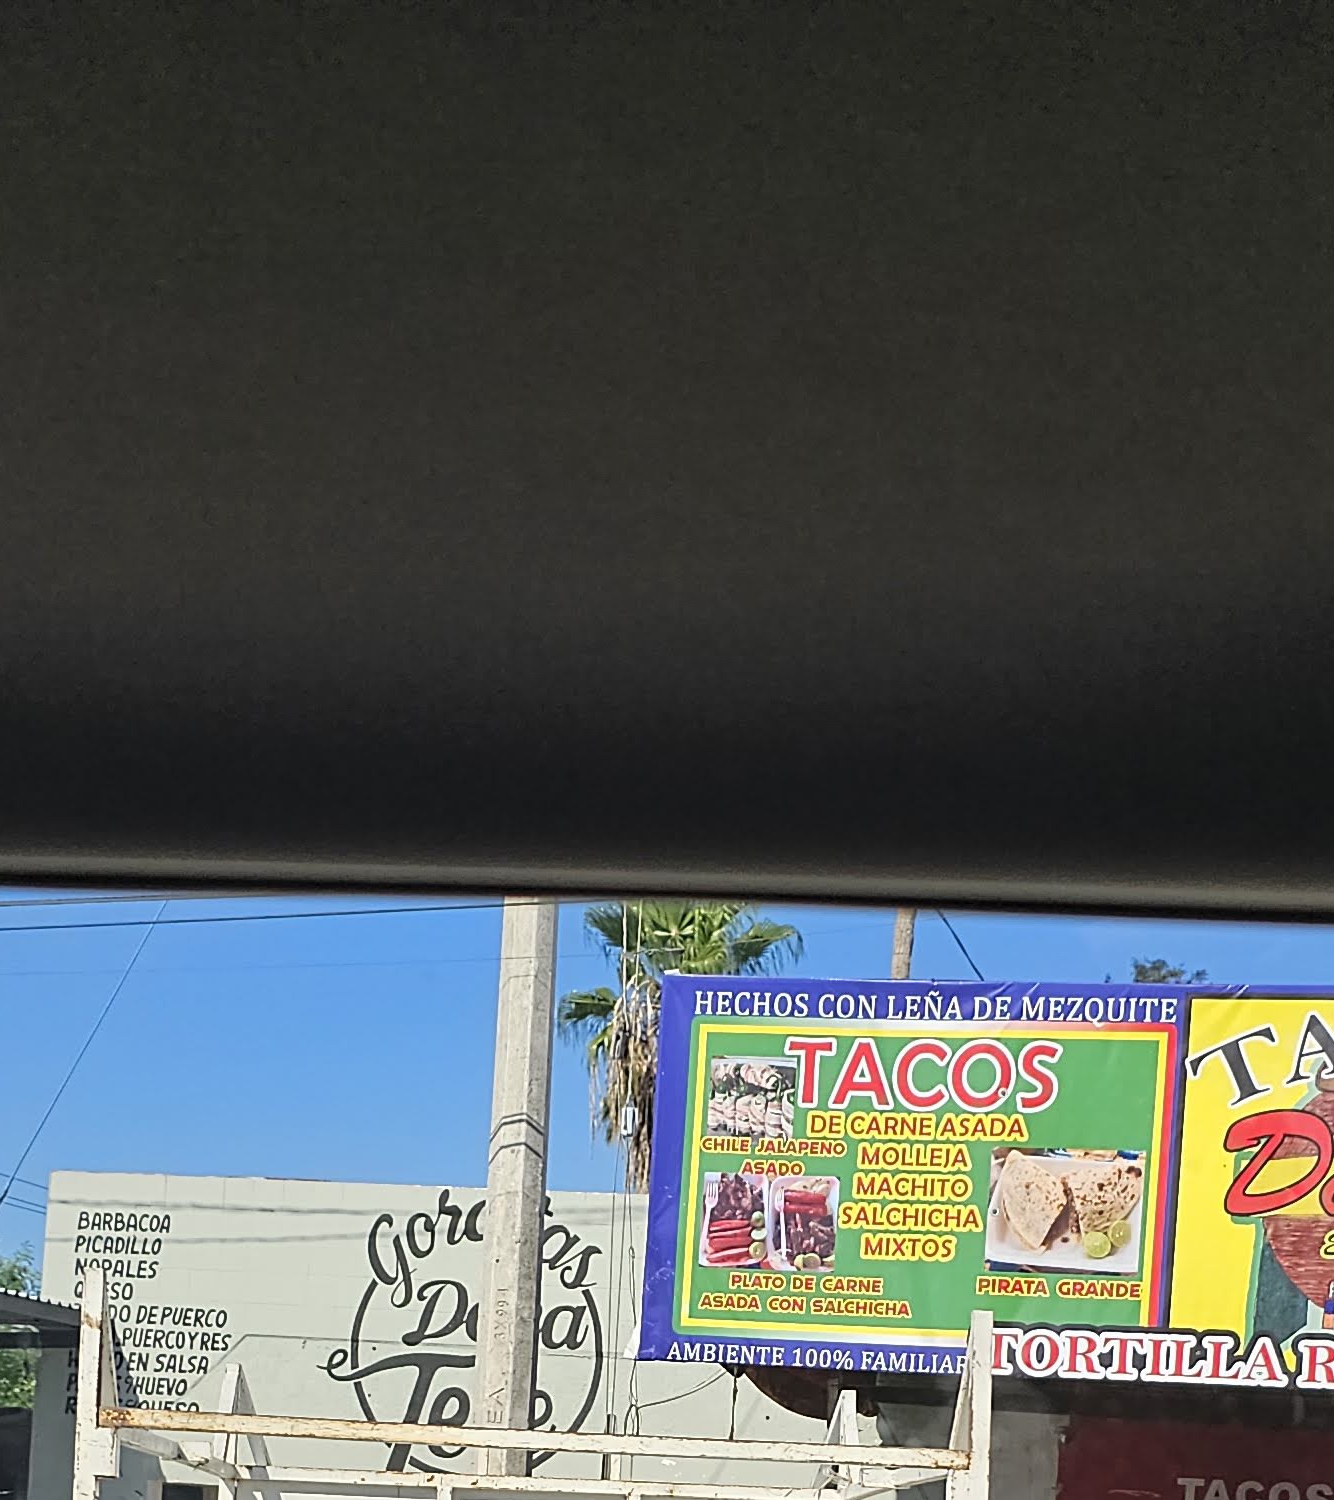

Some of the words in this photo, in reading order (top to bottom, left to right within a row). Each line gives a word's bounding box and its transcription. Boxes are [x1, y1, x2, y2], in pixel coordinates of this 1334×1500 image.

[695, 991, 809, 1017] HECHOS
[818, 993, 881, 1019] CON
[888, 990, 961, 1022] LEÑA
[973, 996, 1010, 1020] DE
[1022, 996, 1177, 1027] MEZQUITE
[786, 1036, 1062, 1113] TACOS
[807, 1112, 845, 1136] DE
[848, 1113, 933, 1138] CARNE
[938, 1115, 1027, 1140] ASADA
[701, 1138, 751, 1153] CHILE
[860, 1145, 970, 1169] MOLLEJA
[742, 1161, 805, 1177] ASADO
[853, 1175, 972, 1199] MACHITO
[77, 1211, 171, 1234] BARBACOA
[840, 1205, 982, 1231] SALCHICHA
[75, 1235, 162, 1255] PICADILLO
[860, 1235, 954, 1259] MIXTOS
[729, 1273, 786, 1290] PLATO
[791, 1275, 815, 1291] DE
[821, 1277, 883, 1295] CARNE
[977, 1277, 1048, 1297] PIRATA
[1057, 1280, 1142, 1299] GRANDE
[136, 1306, 159, 1324] DE
[160, 1307, 228, 1328] PUERCO
[700, 1295, 760, 1311] ASADA
[768, 1297, 806, 1313] CON
[812, 1300, 912, 1318] SALCHICHA
[122, 1328, 185, 1349] PUERCO
[199, 1333, 232, 1351] RES
[128, 1353, 150, 1371] EN
[154, 1354, 209, 1374] SALSA
[667, 1342, 785, 1366] AMBIENTE
[792, 1346, 854, 1369] 100%
